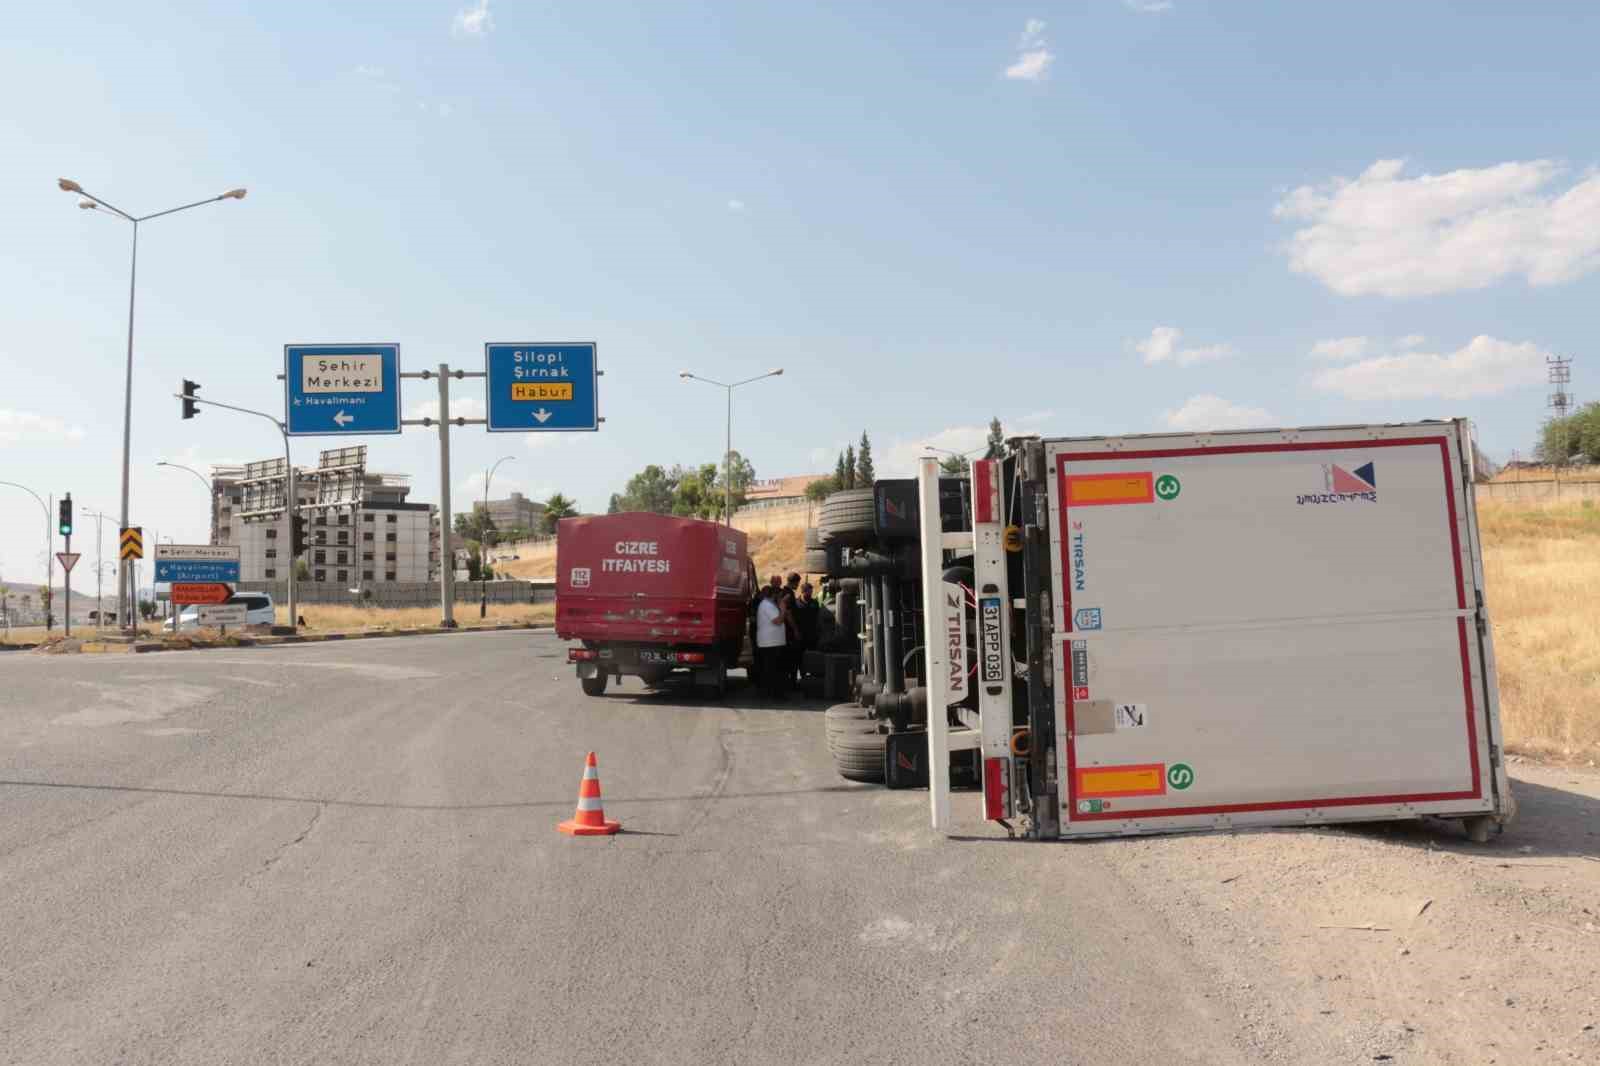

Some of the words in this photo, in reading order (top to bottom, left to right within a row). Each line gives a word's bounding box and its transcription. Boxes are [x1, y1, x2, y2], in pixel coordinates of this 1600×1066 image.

[513, 351, 562, 364] Silopi
[319, 360, 366, 373] Şehir
[513, 366, 569, 379] Şırnak
[307, 376, 378, 388] Merkezi
[515, 386, 567, 398] Habur
[615, 541, 658, 555] CİZRE
[602, 558, 670, 573] İTFAİYESİ
[1073, 533, 1085, 591] TIRSAN
[984, 607, 998, 620] 31
[985, 622, 1000, 652] APP
[948, 612, 963, 691] TIRSAN
[987, 655, 1001, 679] 036
